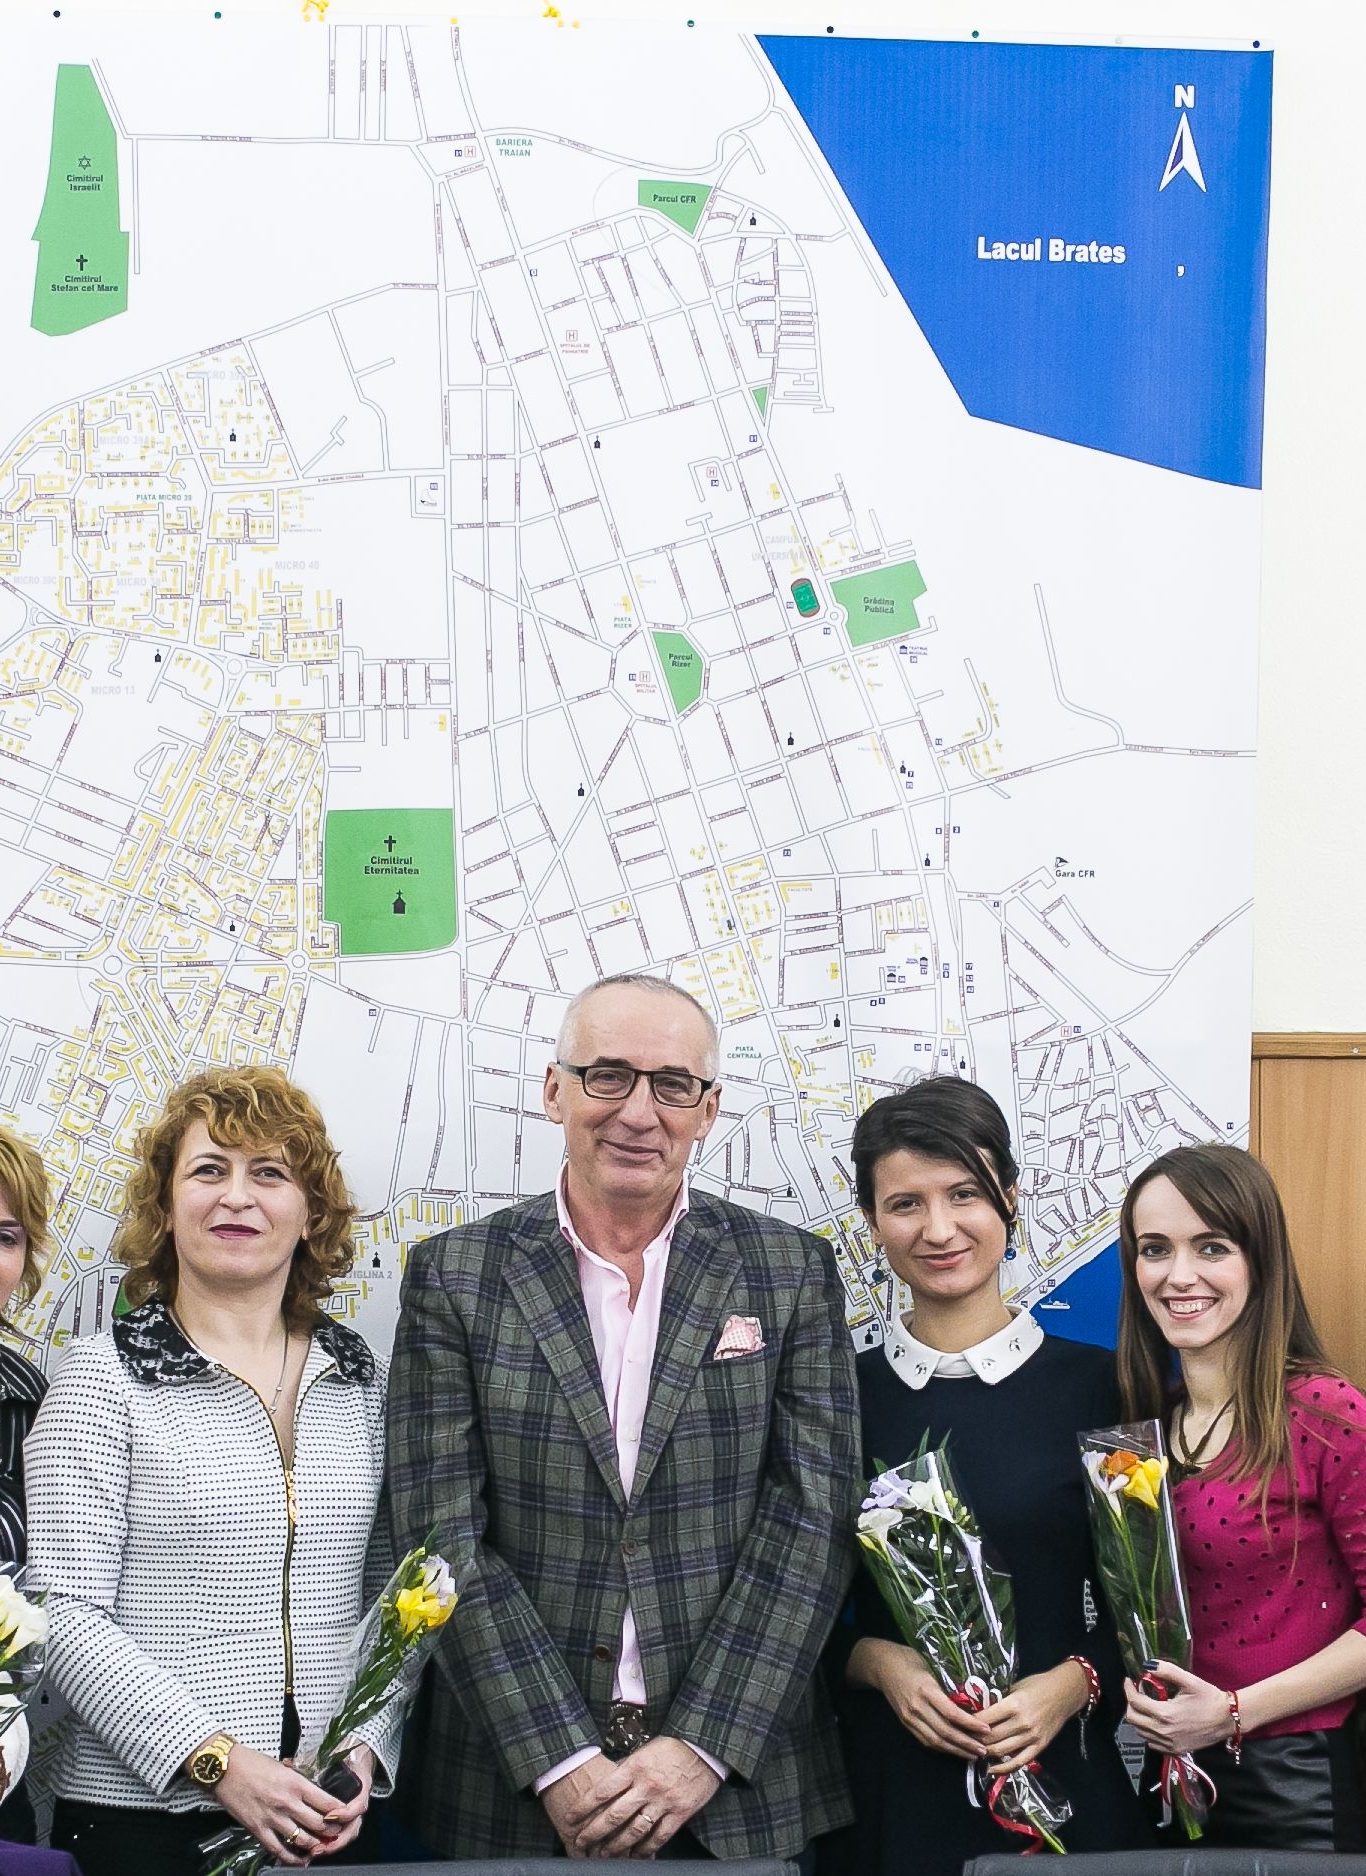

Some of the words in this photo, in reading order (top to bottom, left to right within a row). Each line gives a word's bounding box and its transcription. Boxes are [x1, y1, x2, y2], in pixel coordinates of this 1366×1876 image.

[1174, 83, 1197, 110] N
[496, 138, 533, 146] BARIERA
[499, 149, 531, 157] TRAIAN
[66, 174, 103, 183] Cimitirul
[70, 183, 100, 191] Israelit
[653, 194, 678, 203] Parcul
[680, 195, 697, 204] CFR
[976, 235, 1044, 261] Lacul
[1048, 239, 1128, 264] Brates
[64, 275, 101, 283] Cimitirul
[97, 284, 118, 292] Mare
[275, 560, 305, 570] MICRO
[668, 653, 693, 661] Parcul
[91, 686, 121, 695] MICRO
[370, 856, 412, 865] Cimitirul
[364, 865, 419, 875] Eternitatea
[1055, 869, 1076, 878] Gara
[1078, 870, 1095, 879] CFR
